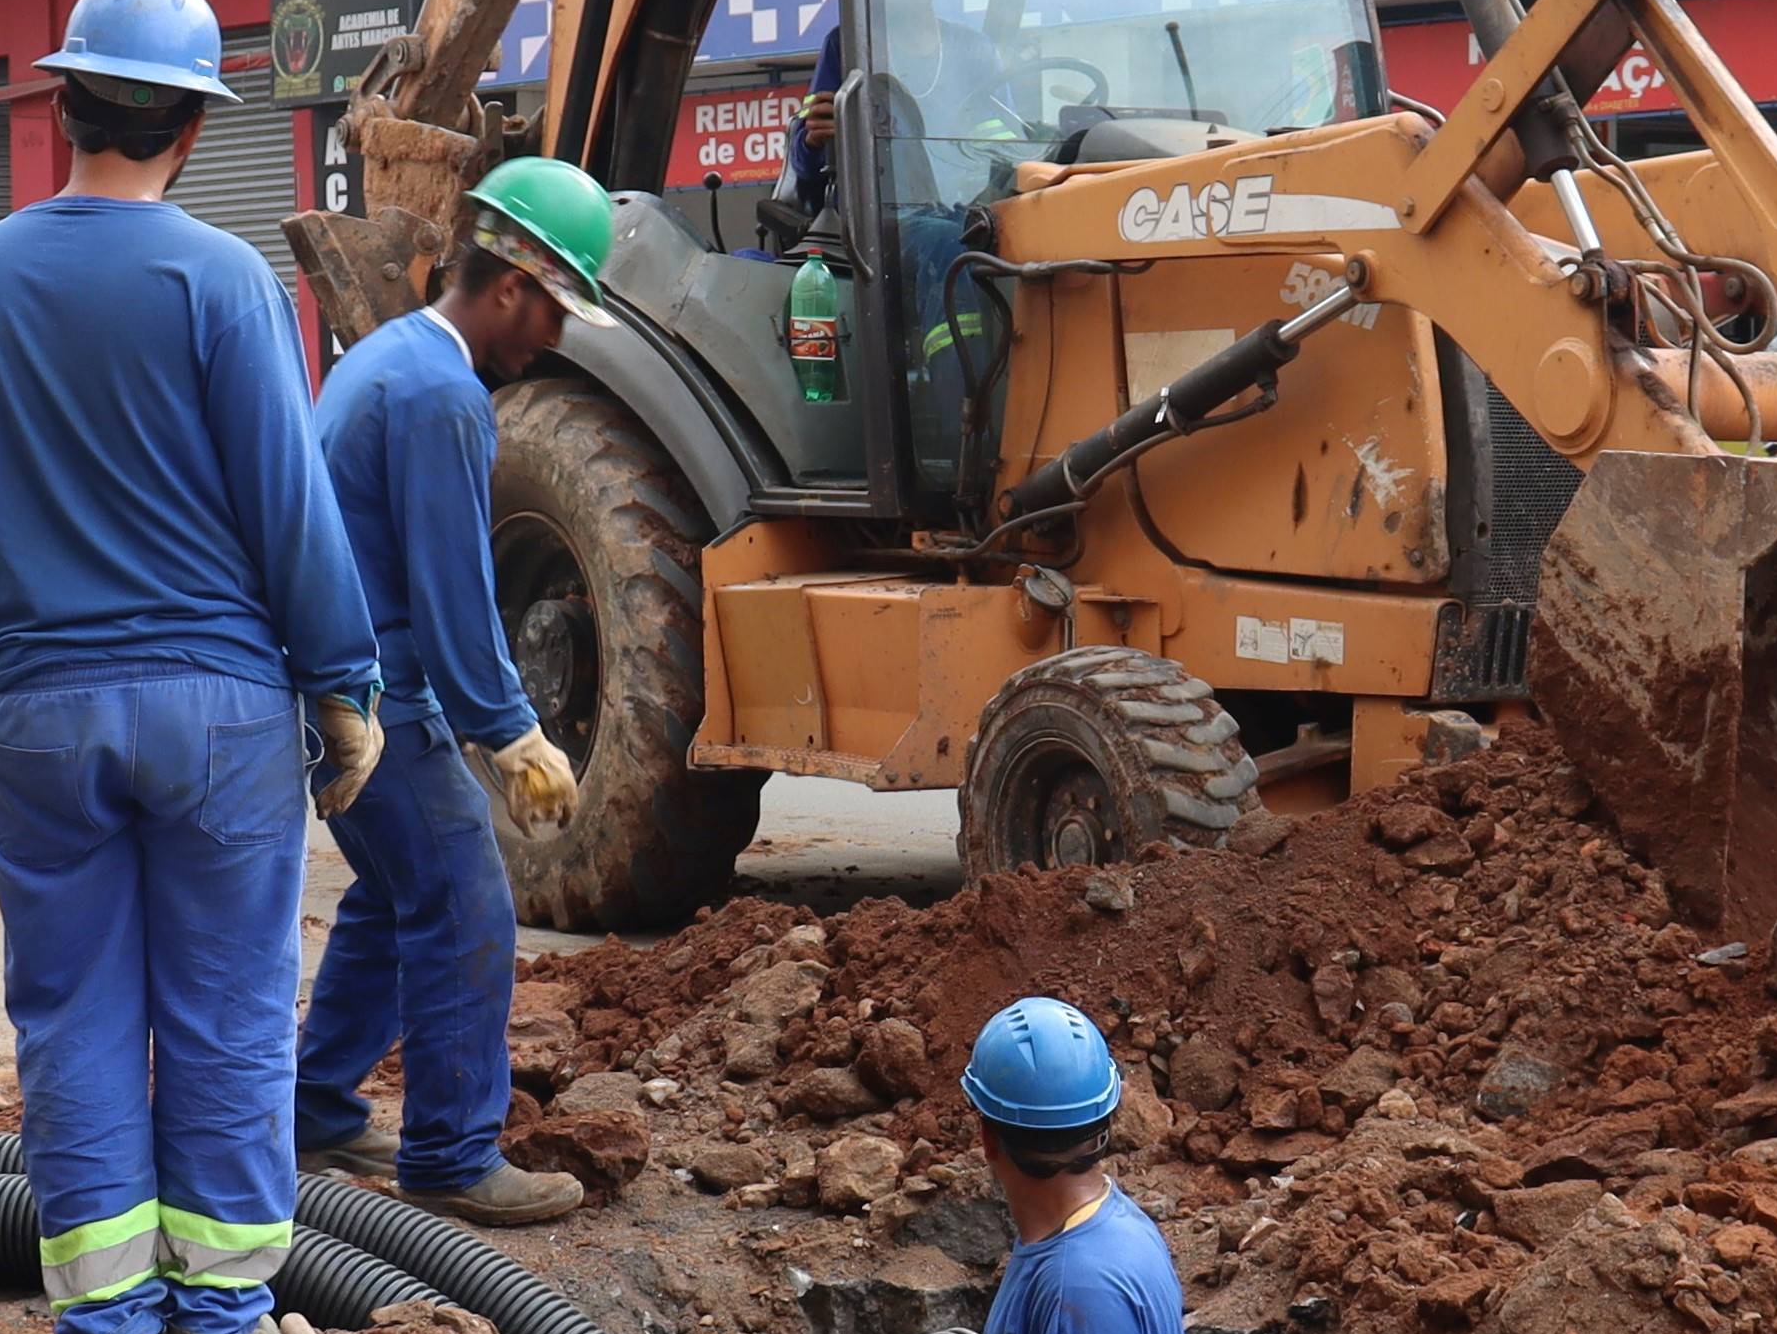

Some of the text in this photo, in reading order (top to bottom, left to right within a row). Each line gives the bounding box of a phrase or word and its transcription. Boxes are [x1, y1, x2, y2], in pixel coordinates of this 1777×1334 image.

[338, 10, 387, 32] ACADEMIA
[387, 7, 400, 25] DE
[331, 31, 361, 51] ARTES
[698, 137, 735, 166] de
[1122, 175, 1273, 242] CASE
